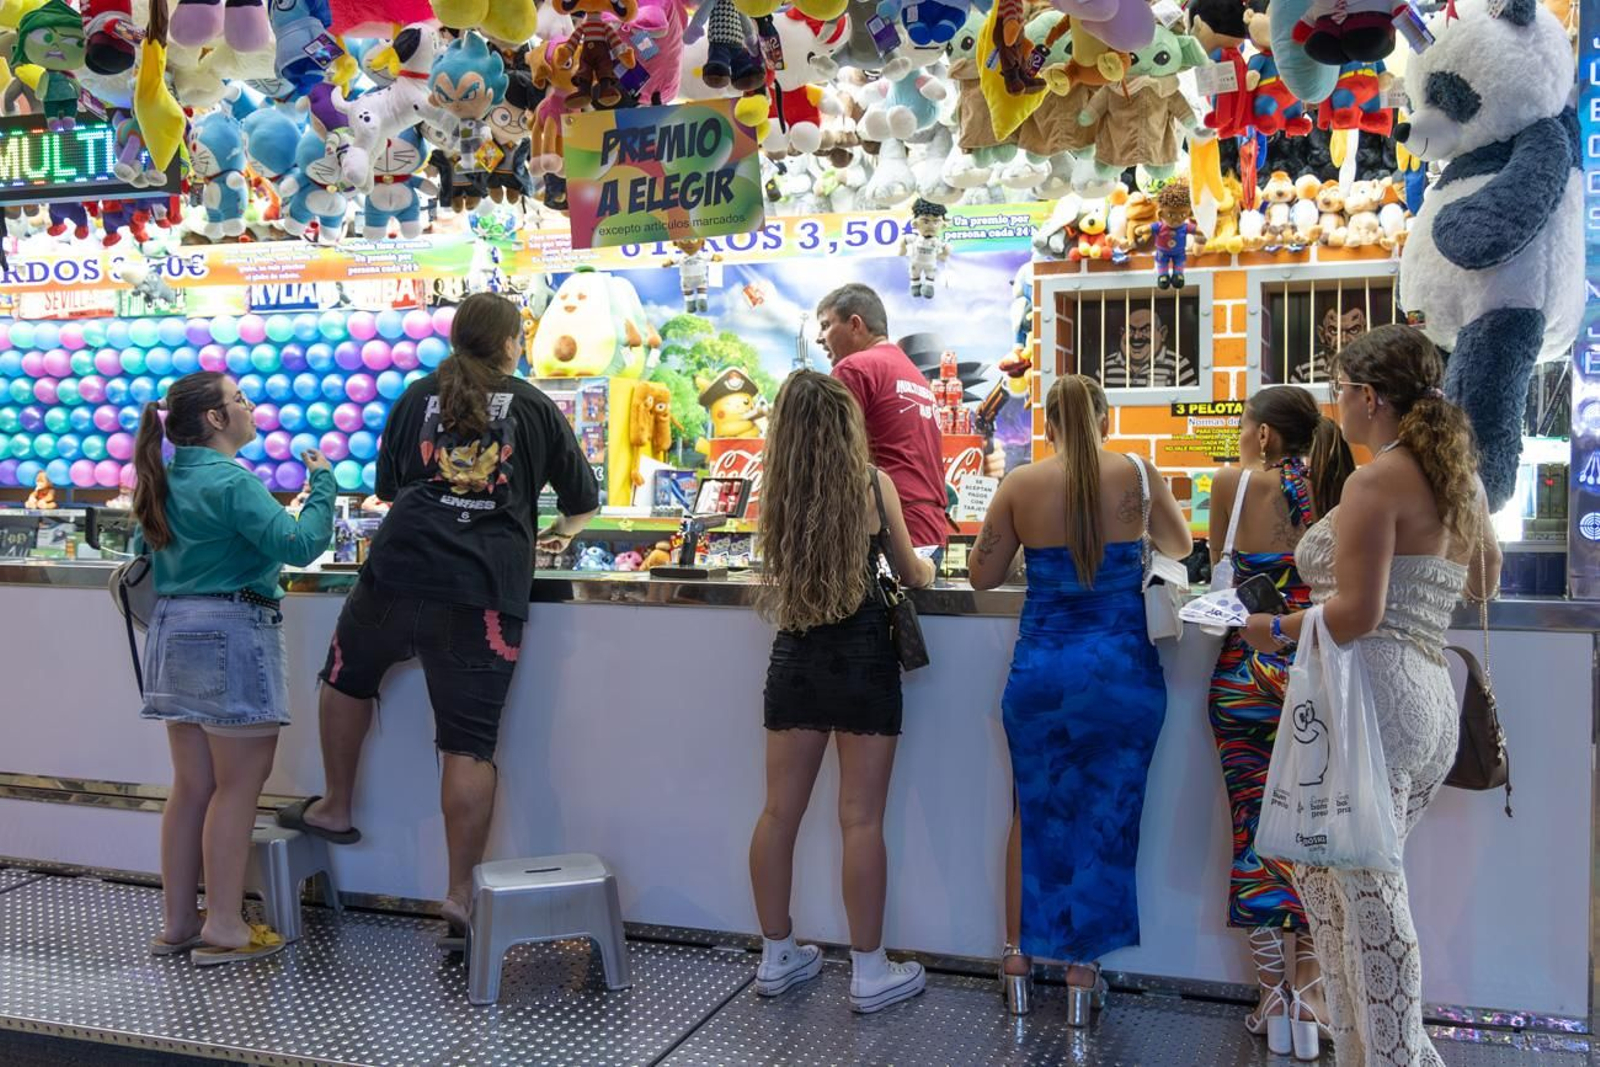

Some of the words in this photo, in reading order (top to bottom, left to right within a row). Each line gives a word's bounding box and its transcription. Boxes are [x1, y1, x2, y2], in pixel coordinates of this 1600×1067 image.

[600, 118, 722, 166] PREMIO
[0, 129, 118, 180] MULTI
[597, 179, 619, 218] A
[628, 169, 736, 215] ELEGIR
[598, 224, 641, 237] excepto
[691, 213, 746, 228] marcados
[954, 216, 968, 226] Un
[970, 214, 1009, 228] premio
[1011, 215, 1030, 226] por
[945, 229, 987, 241] persona
[988, 227, 1015, 238] cada
[1016, 226, 1030, 237] 24
[1176, 404, 1185, 414] 3
[1189, 402, 1243, 415] PELOTA
[1189, 418, 1224, 427] Normas
[1227, 418, 1241, 427] de
